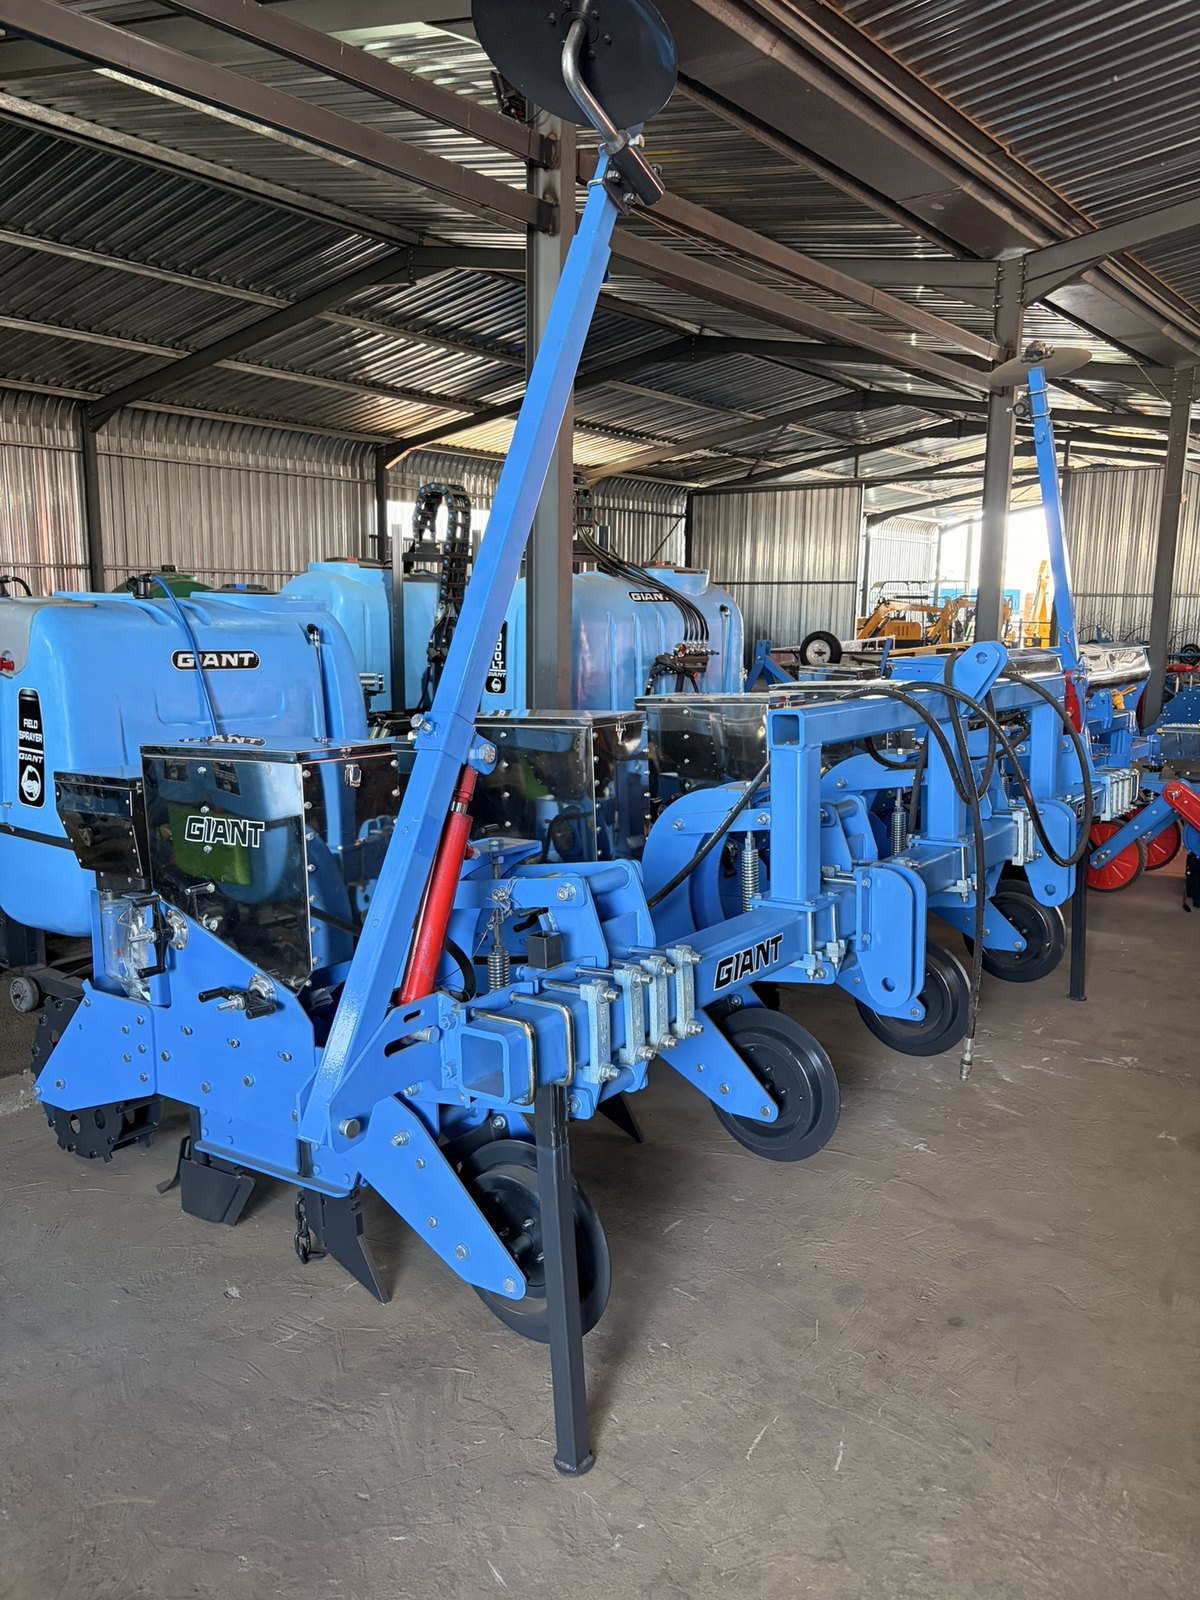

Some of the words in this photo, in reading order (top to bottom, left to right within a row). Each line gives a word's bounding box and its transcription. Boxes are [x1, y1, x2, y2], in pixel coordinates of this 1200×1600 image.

[631, 593, 670, 601] GIAN
[23, 718, 38, 729] FIELD
[19, 730, 43, 743] SPRAYER
[19, 752, 43, 763] GIANT
[184, 815, 266, 848] GIANT
[713, 932, 784, 991] GIANT
